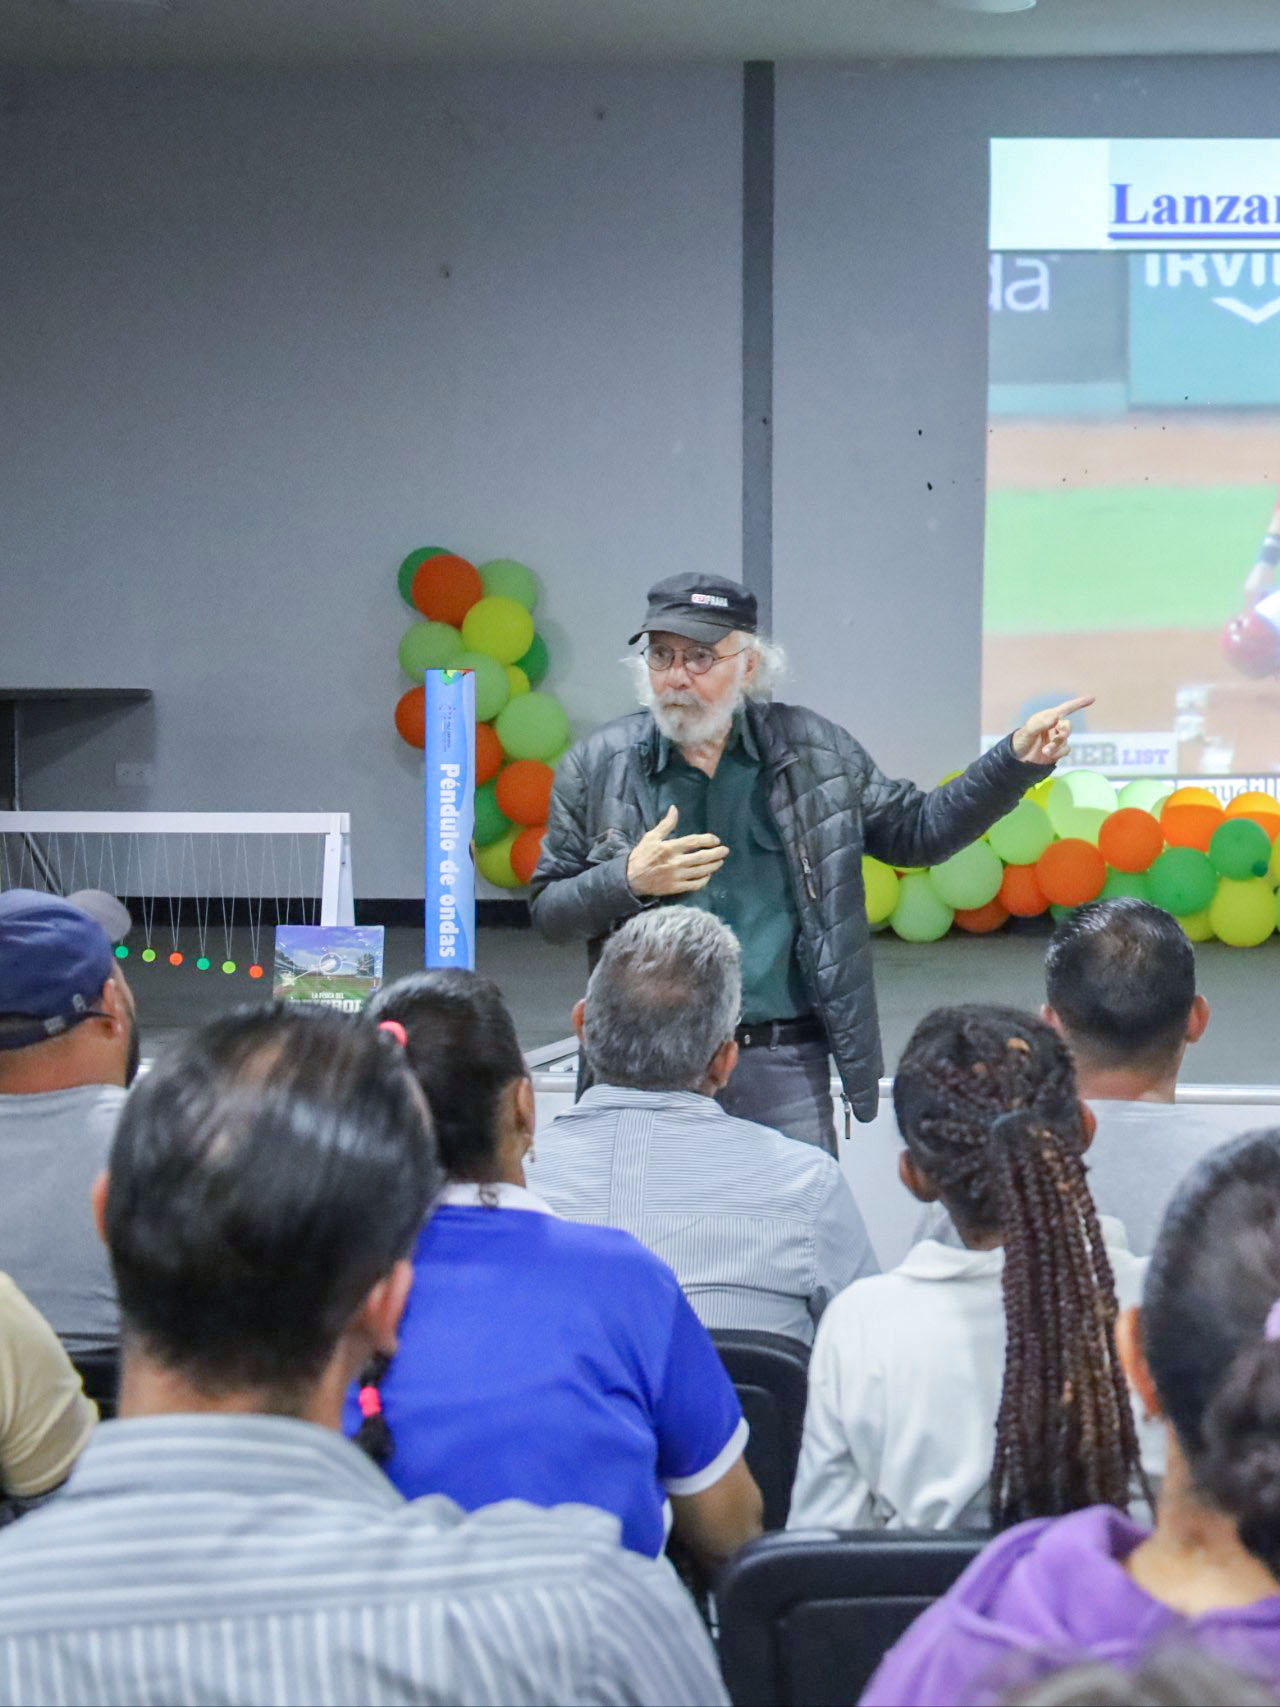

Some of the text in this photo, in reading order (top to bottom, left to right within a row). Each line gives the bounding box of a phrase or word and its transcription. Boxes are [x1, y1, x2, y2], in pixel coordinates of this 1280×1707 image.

[1122, 749, 1169, 766] LIST
[440, 763, 461, 851] Péndulo
[440, 860, 460, 886] de
[439, 893, 460, 958] ondas
